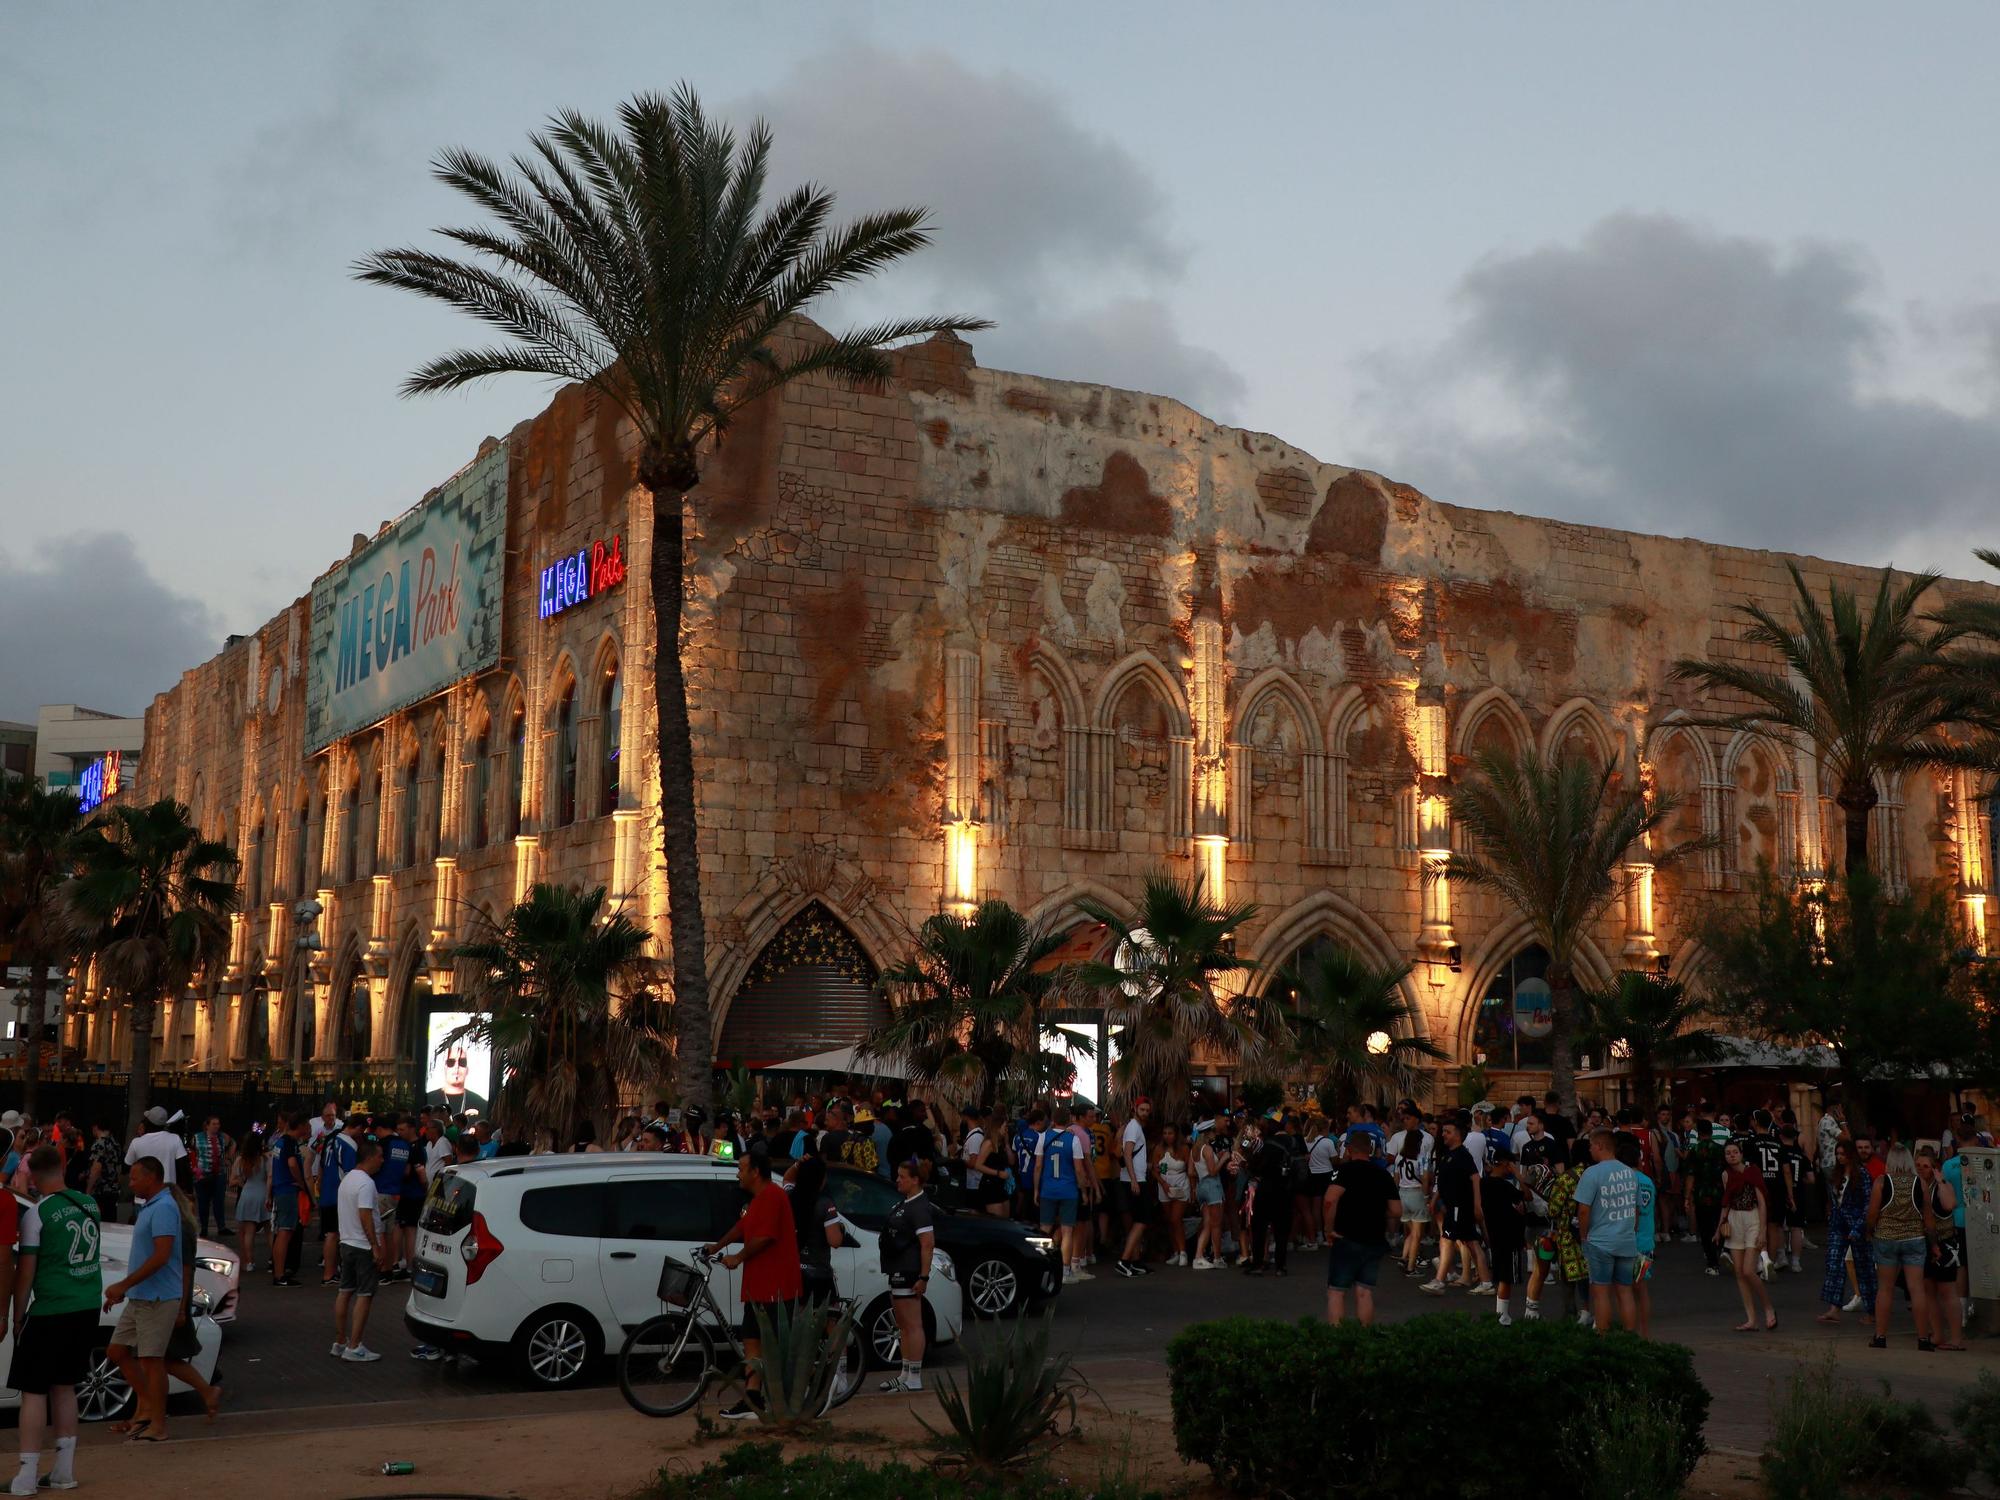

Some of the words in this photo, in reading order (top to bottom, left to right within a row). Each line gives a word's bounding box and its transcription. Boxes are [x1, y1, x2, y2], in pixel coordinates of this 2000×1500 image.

[539, 550, 588, 620] MEGA
[590, 535, 624, 596] Park
[336, 560, 410, 694] MEGA
[412, 544, 460, 651] Park
[1050, 1153, 1060, 1179] 1
[1758, 1147, 1779, 1172] 15
[1608, 1170, 1632, 1182] ANTI
[1608, 1208, 1636, 1222] CLUB
[66, 1217, 99, 1264] 29
